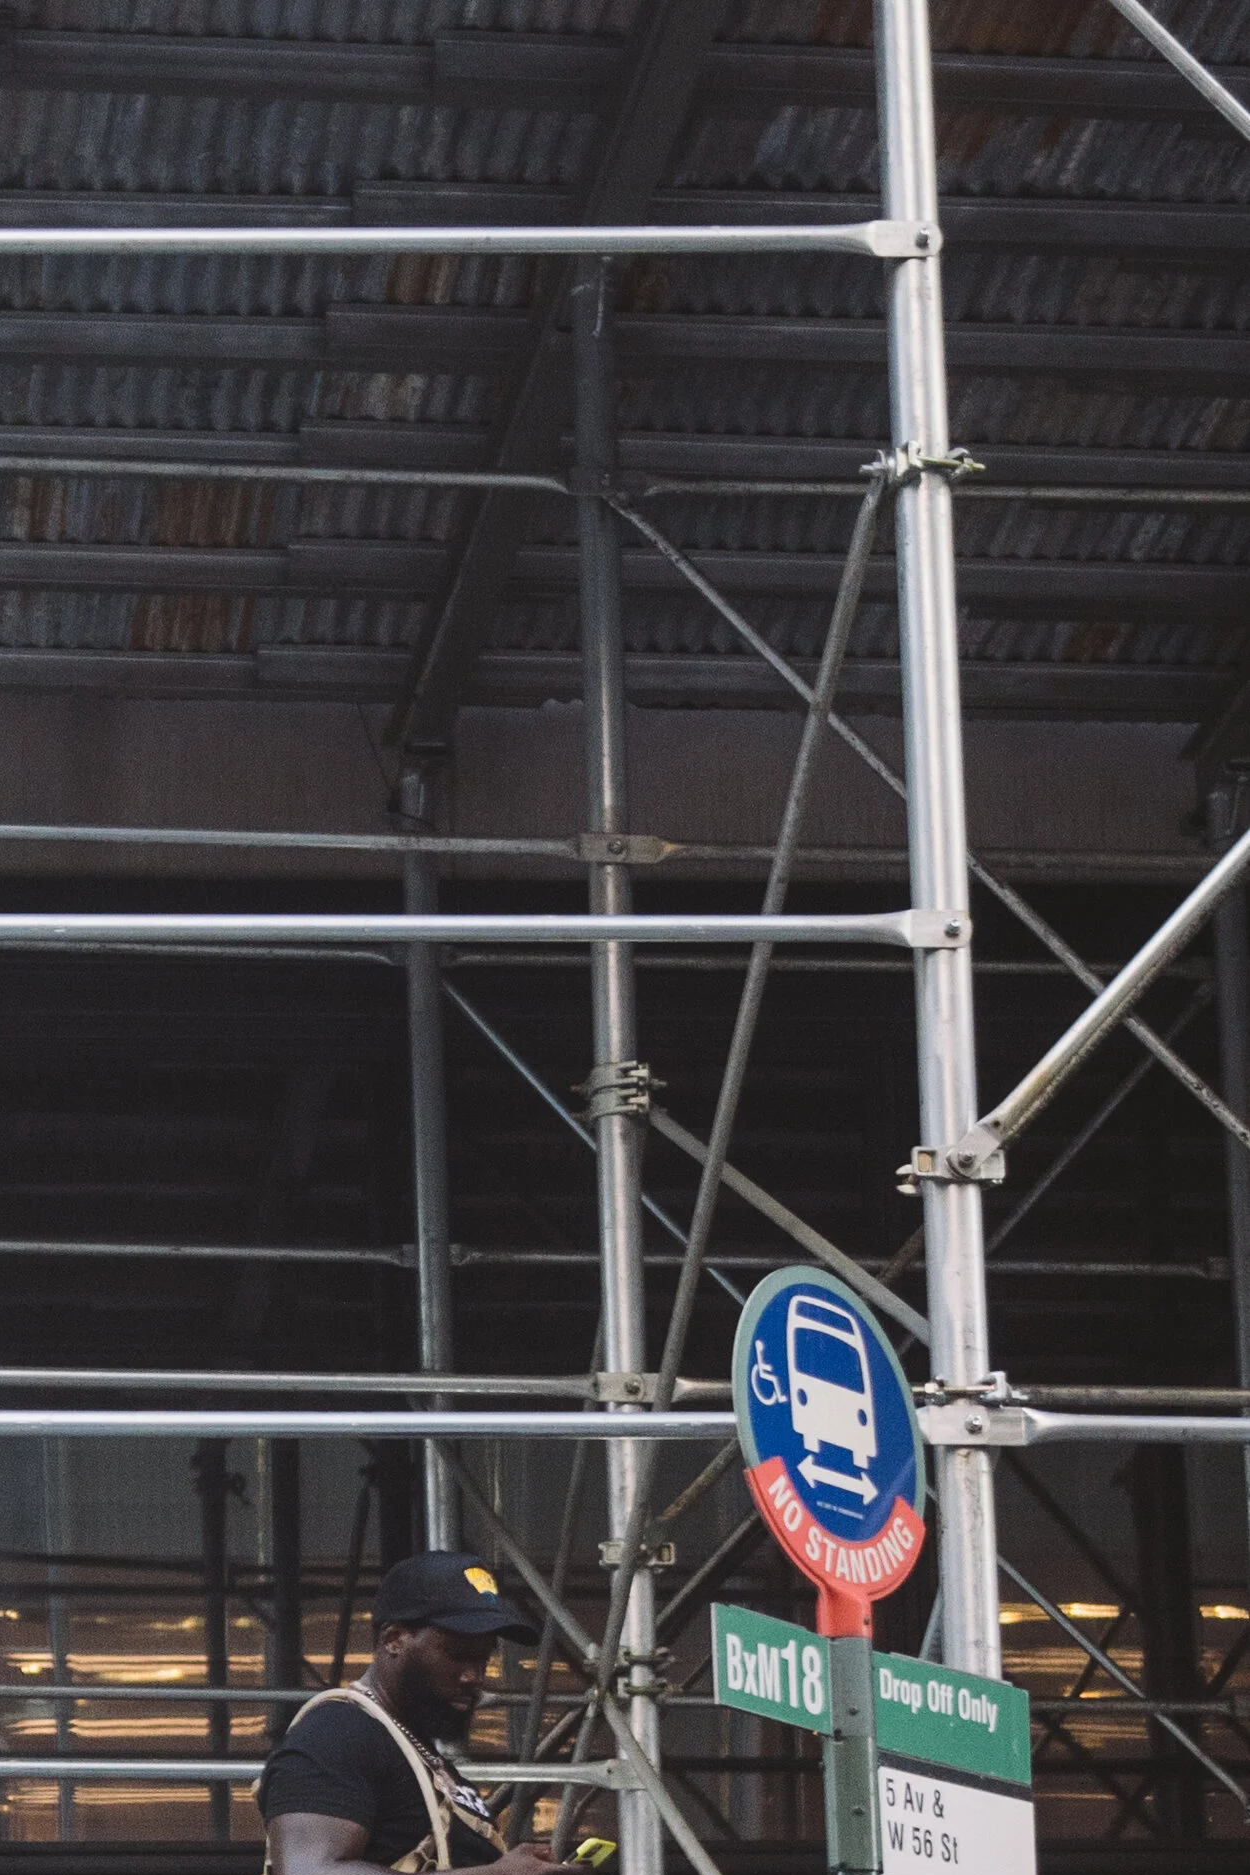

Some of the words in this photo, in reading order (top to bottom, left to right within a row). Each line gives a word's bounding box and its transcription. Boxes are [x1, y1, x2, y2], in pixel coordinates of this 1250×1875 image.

[768, 1475, 803, 1533] NO
[805, 1517, 915, 1584] STANDING
[726, 1633, 824, 1715] BxM18
[879, 1667, 923, 1713] Drop
[927, 1680, 954, 1715] Off
[958, 1689, 998, 1733] Only
[885, 1777, 896, 1807] 5
[903, 1782, 924, 1814] Av
[932, 1789, 945, 1819] &
[887, 1820, 904, 1852] W
[912, 1826, 933, 1858] 56
[941, 1833, 958, 1864] St
